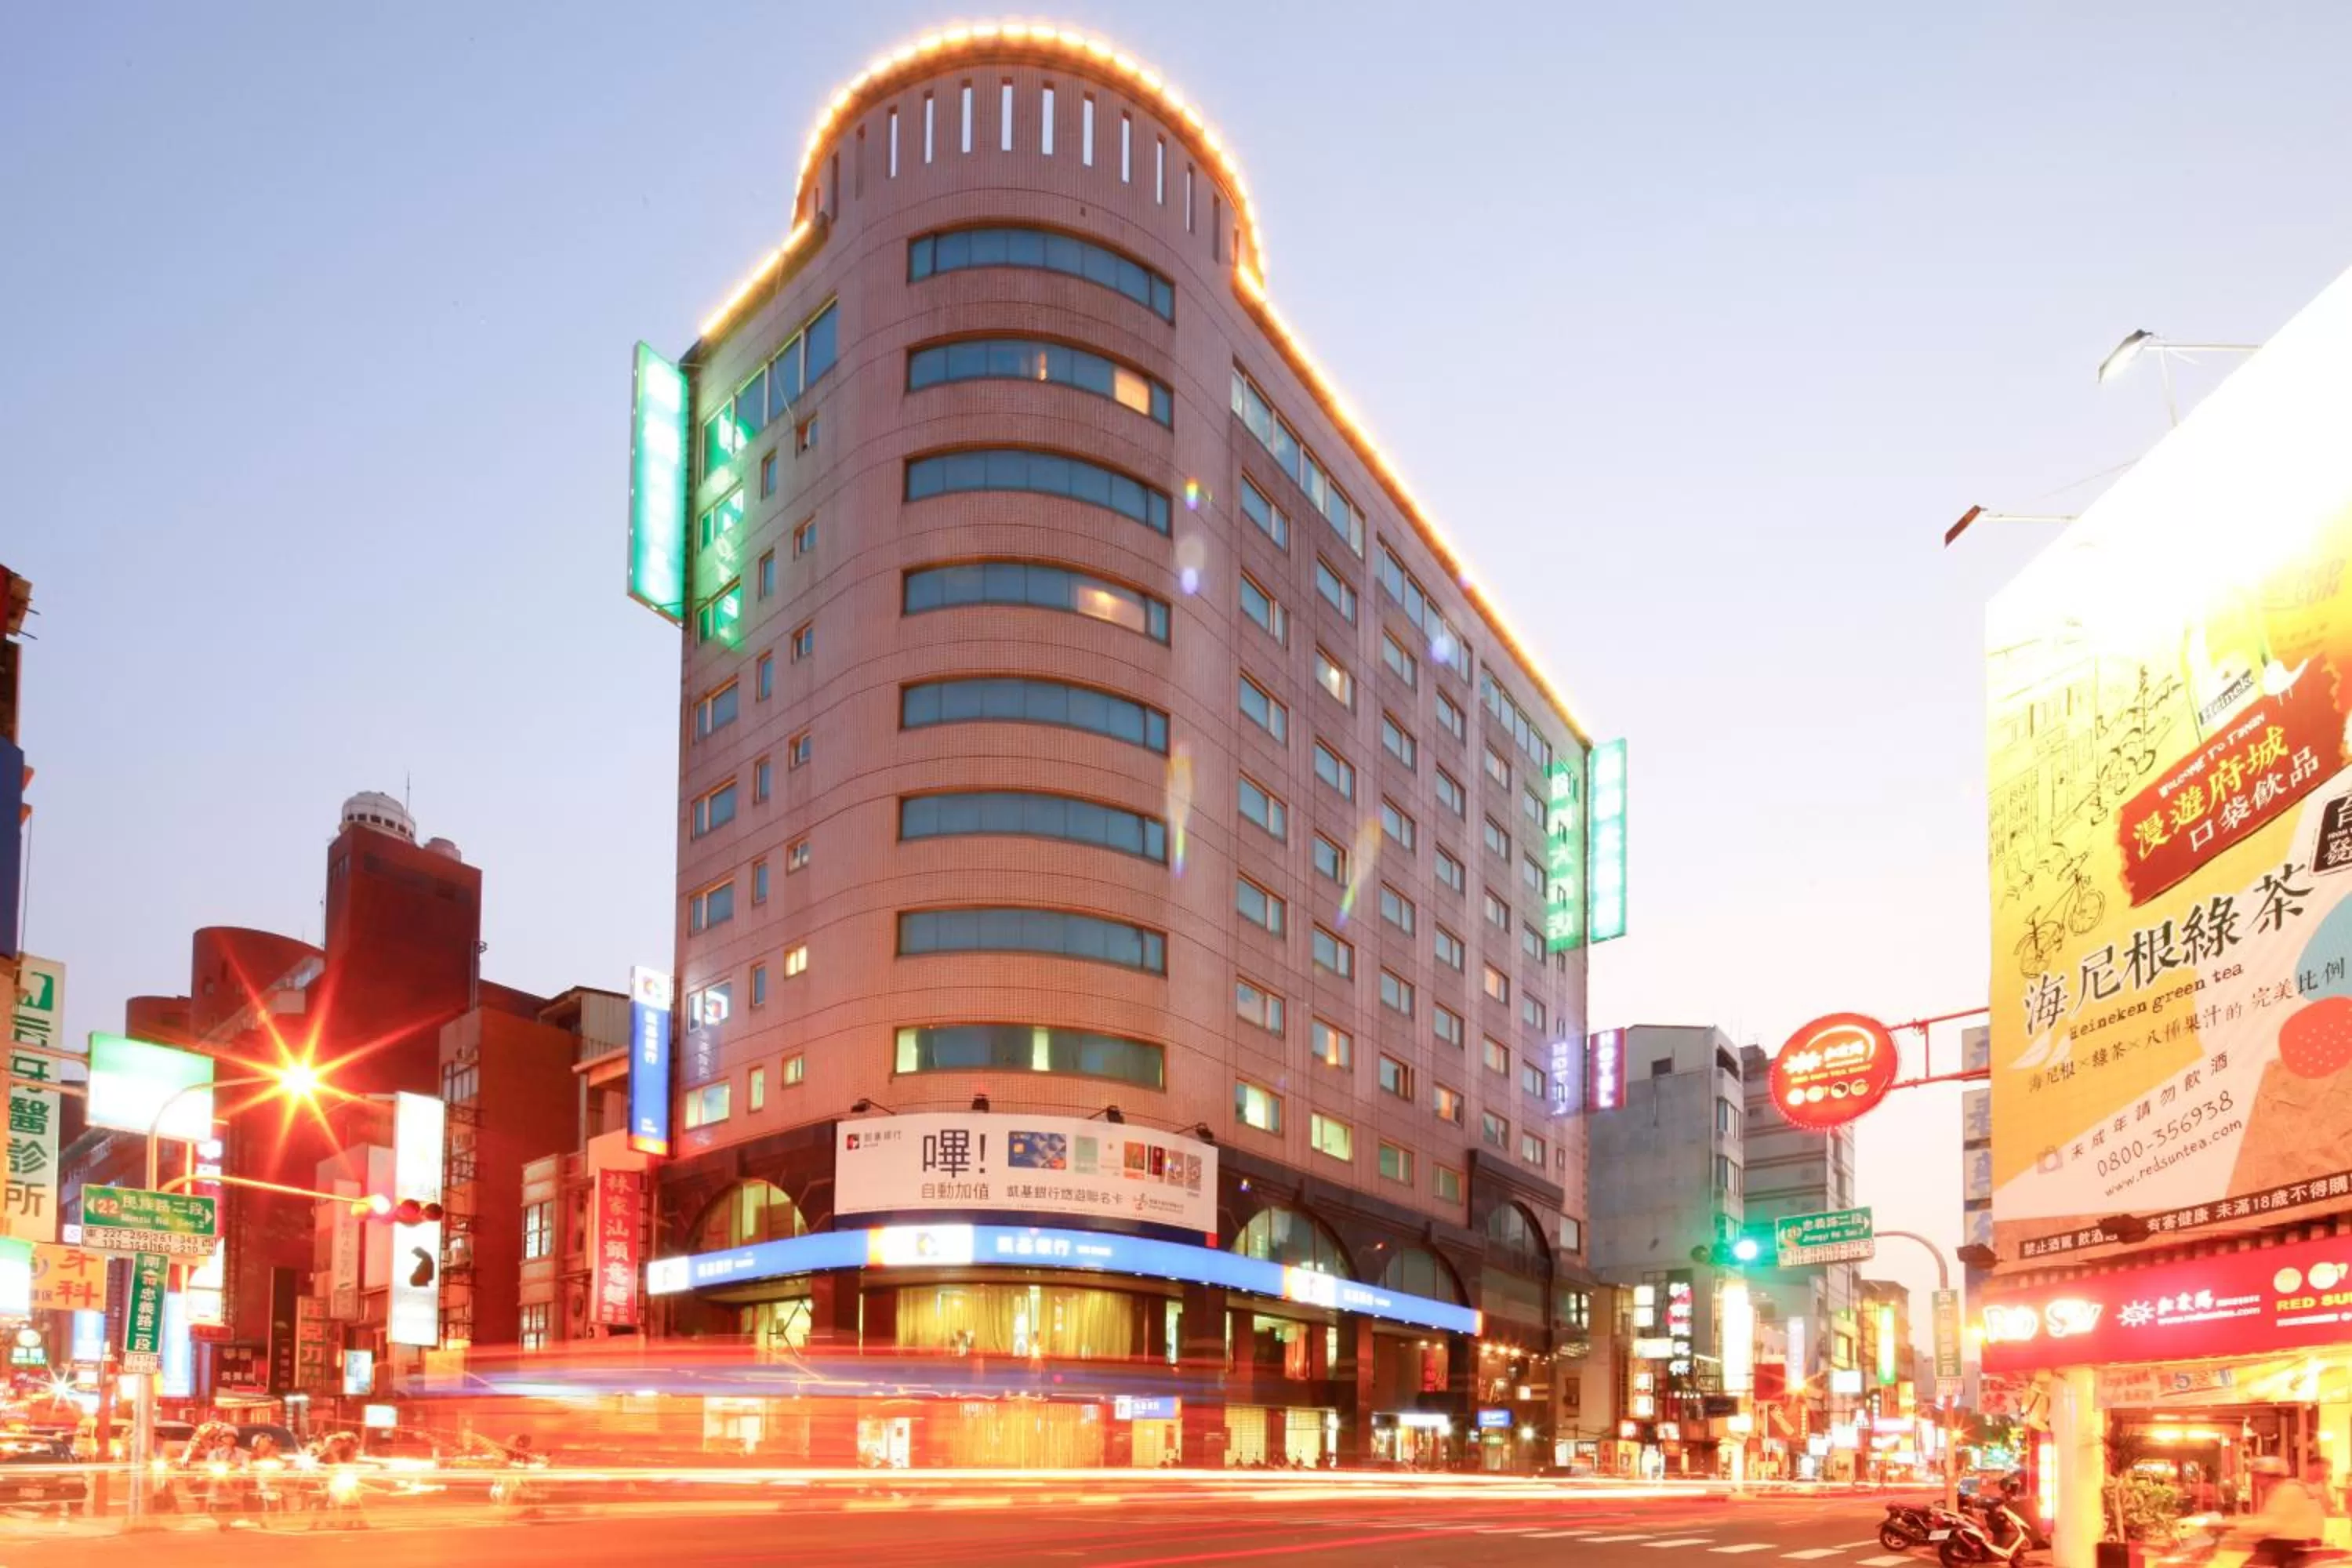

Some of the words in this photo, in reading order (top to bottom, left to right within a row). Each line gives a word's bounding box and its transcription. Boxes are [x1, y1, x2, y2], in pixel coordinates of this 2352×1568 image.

[2190, 746, 2319, 852] 口袋飲品
[2024, 863, 2314, 1036] 海尼根綠茶
[2069, 1000, 2147, 1041] Heineken
[2151, 978, 2206, 1014] green
[2211, 963, 2244, 983] tea
[1599, 1031, 1614, 1107] HOTEL
[2096, 1089, 2234, 1178] 0800-356938
[2104, 1119, 2243, 1196] www.redsuntea.com
[96, 1199, 119, 1214] 22
[921, 1182, 989, 1200] 自動加值
[2216, 1173, 2352, 1219] 未滿18歲不得購
[2275, 1296, 2316, 1312] RED
